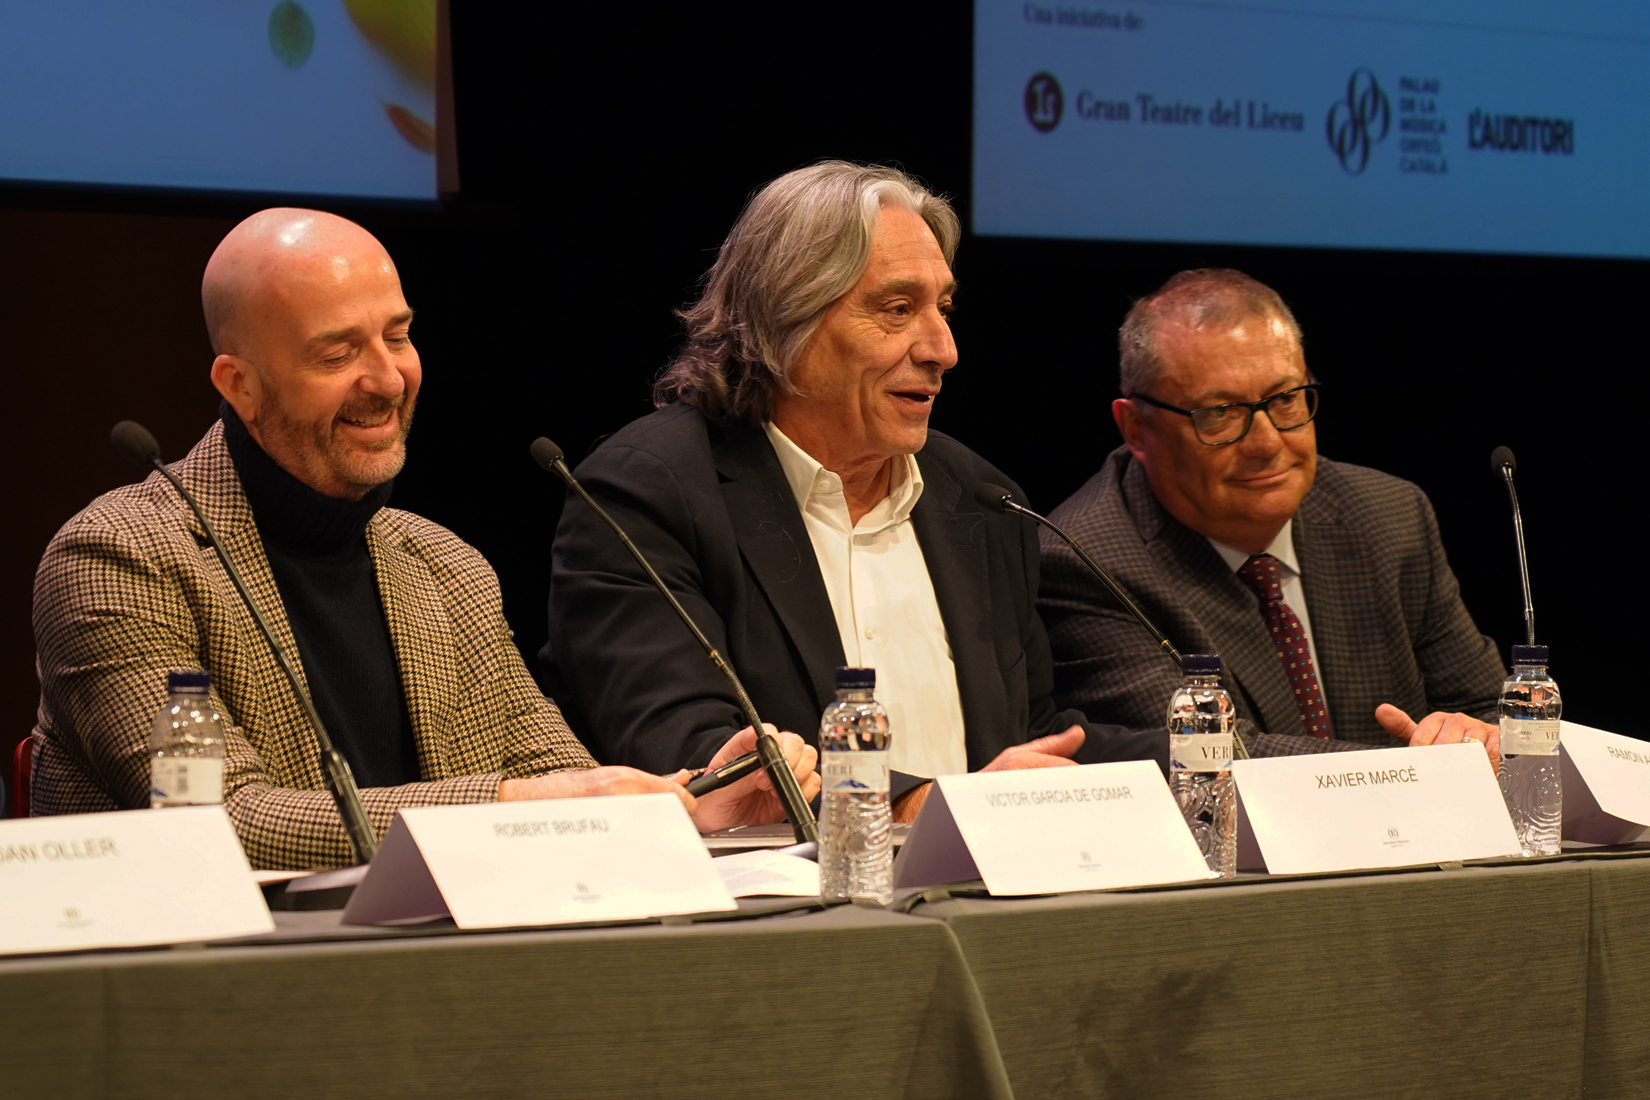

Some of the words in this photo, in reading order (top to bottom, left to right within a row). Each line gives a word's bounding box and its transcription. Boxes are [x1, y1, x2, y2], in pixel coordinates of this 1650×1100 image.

[1399, 77, 1440, 94] PALAU
[1077, 89, 1131, 121] Gran
[1135, 92, 1203, 125] Teatre
[1209, 98, 1241, 128] del
[1247, 100, 1304, 132] Liceu
[1400, 97, 1415, 112] DE
[1420, 98, 1436, 113] LA
[1467, 107, 1574, 156] L'AUDITORI
[1545, 731, 1559, 741] VER
[1201, 746, 1232, 760] VERI
[1606, 746, 1645, 765] RAMON
[1315, 771, 1367, 789] XAVIER
[1369, 765, 1419, 785] MARCÉ
[985, 791, 1030, 807] VICTOR
[1031, 788, 1073, 804] GARCIA
[1074, 787, 1092, 802] DE
[1093, 785, 1133, 802] GOMAR
[493, 820, 552, 838] ROBERT
[554, 817, 610, 836] BRUFAU
[42, 837, 120, 861] OLLER
